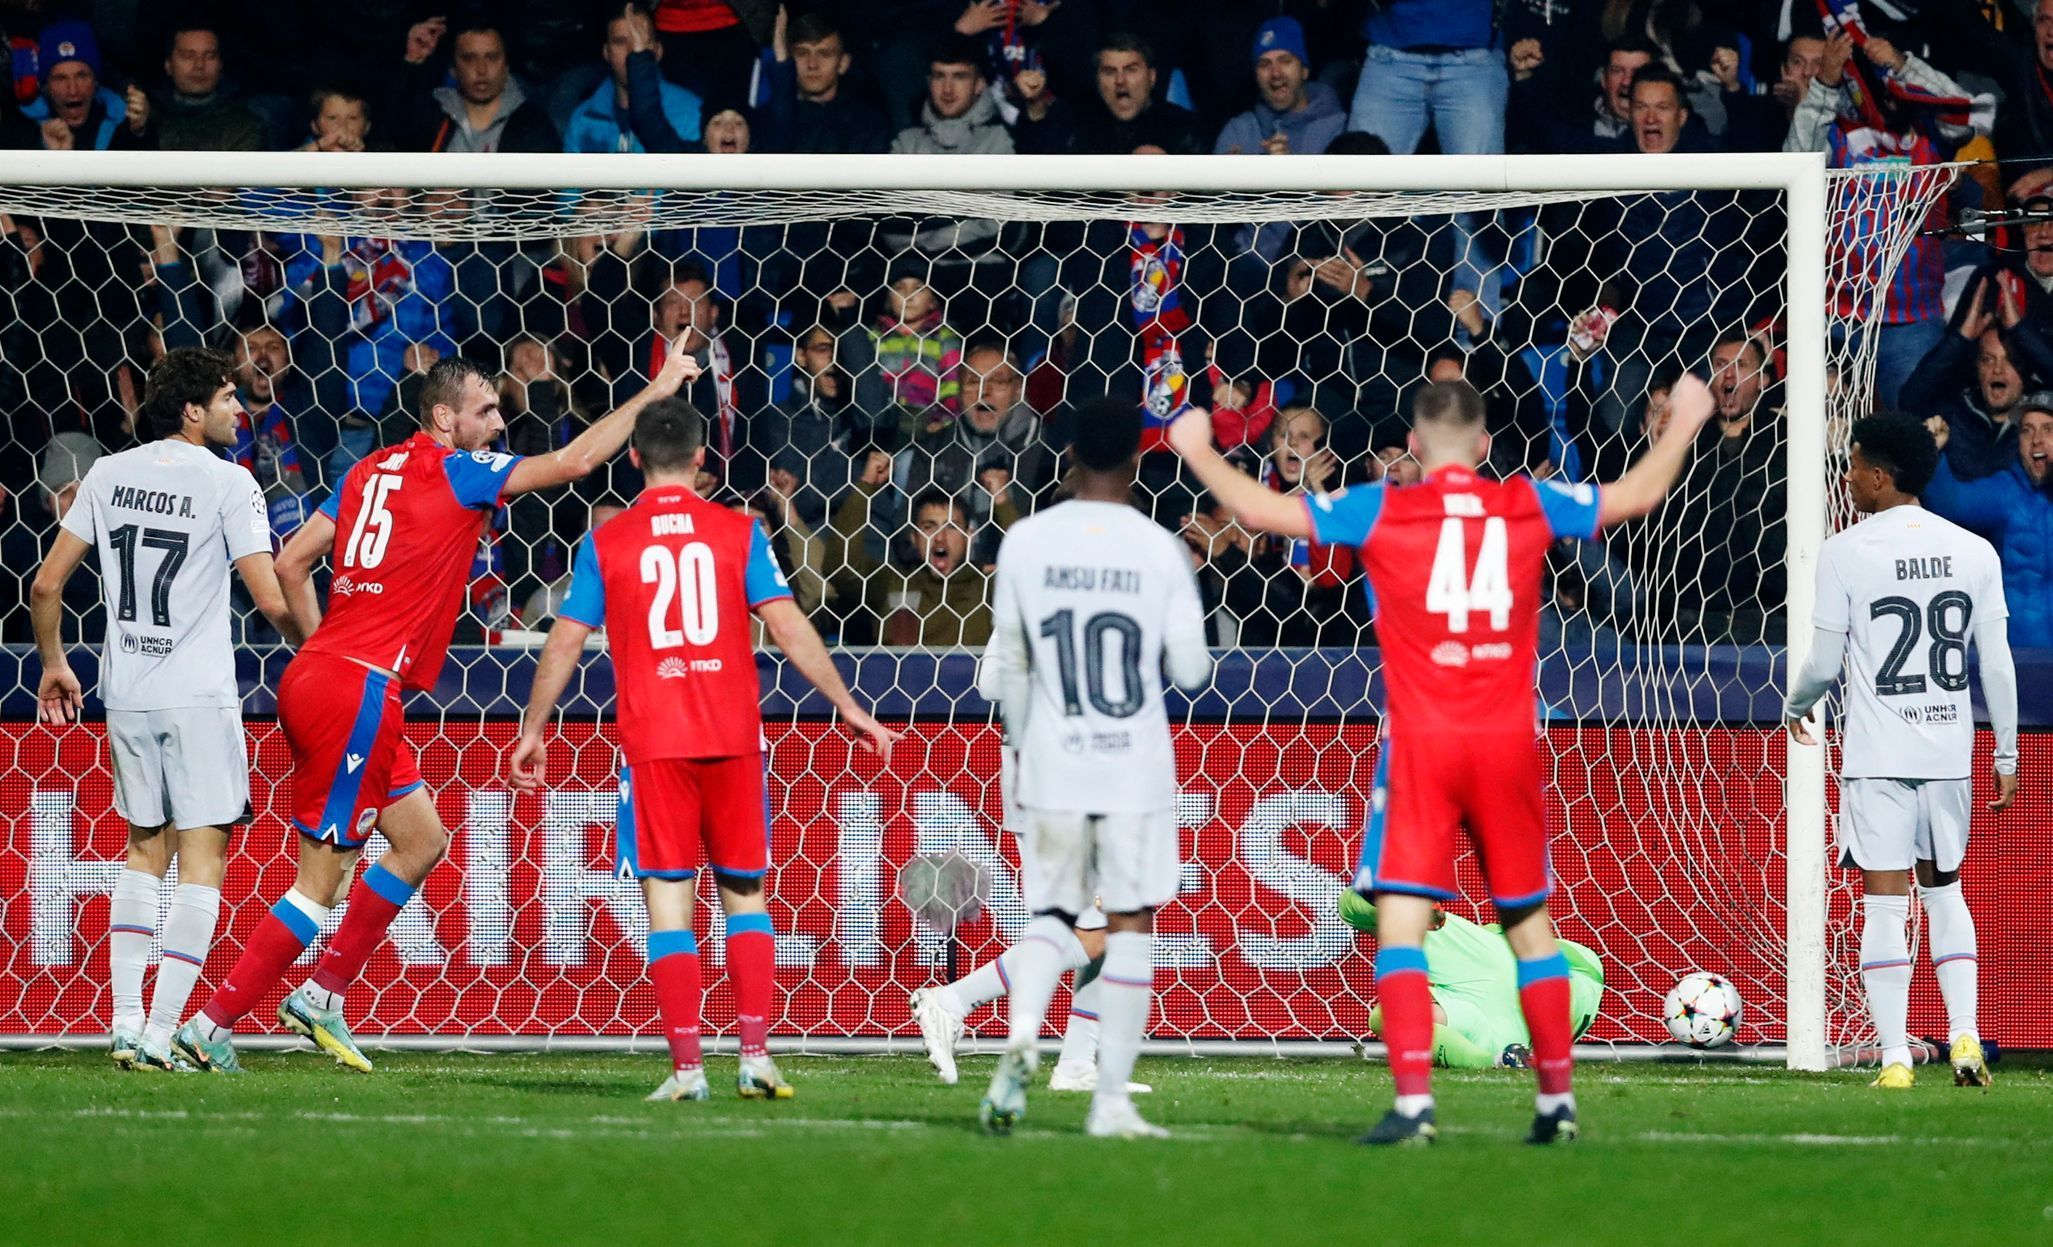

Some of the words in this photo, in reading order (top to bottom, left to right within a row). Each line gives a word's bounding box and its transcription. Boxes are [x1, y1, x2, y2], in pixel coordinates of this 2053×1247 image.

[110, 485, 175, 515] MARCOS
[179, 496, 198, 519] A.
[343, 473, 404, 570] 15
[651, 513, 695, 537] BUCHA
[109, 523, 190, 628] 17
[640, 541, 719, 650] 20
[1043, 566, 1095, 592] ANSU
[1101, 568, 1142, 595] FATI
[1425, 516, 1514, 634] 44
[1895, 556, 1953, 581] BALDE
[140, 635, 173, 647] UNHCR
[1040, 608, 1146, 719] 10
[1869, 590, 1973, 697] 28
[1924, 704, 1957, 714] UNHCR
